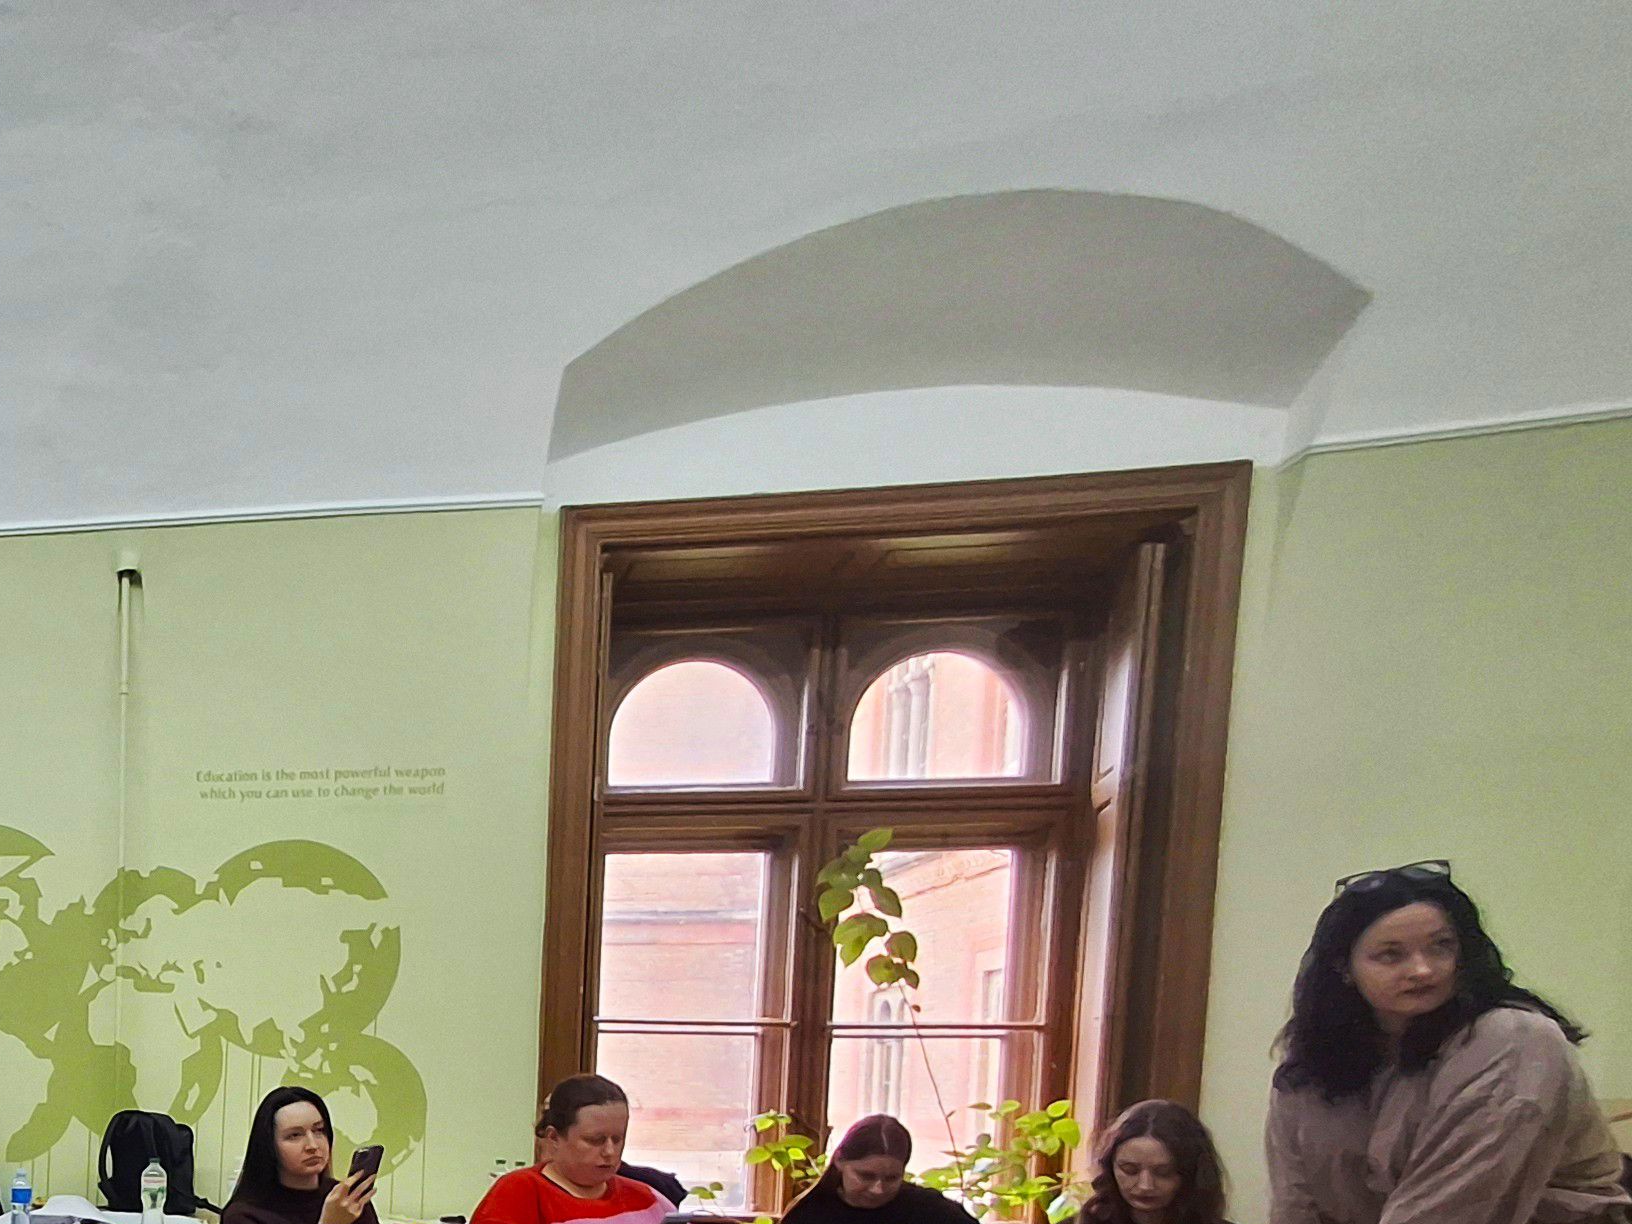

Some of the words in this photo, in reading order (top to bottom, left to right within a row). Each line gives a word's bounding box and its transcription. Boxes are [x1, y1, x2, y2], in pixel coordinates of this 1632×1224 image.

[196, 770, 258, 782] Education
[261, 769, 271, 781] is
[275, 769, 296, 781] the
[299, 768, 330, 780] most
[334, 766, 391, 783] powerful
[394, 767, 446, 780] weapon
[199, 787, 236, 799] which
[239, 789, 262, 803] you
[266, 789, 289, 799] can
[291, 788, 313, 798] use
[317, 786, 331, 797] to
[334, 785, 380, 800] change
[383, 783, 404, 795] the
[408, 782, 445, 796] world
